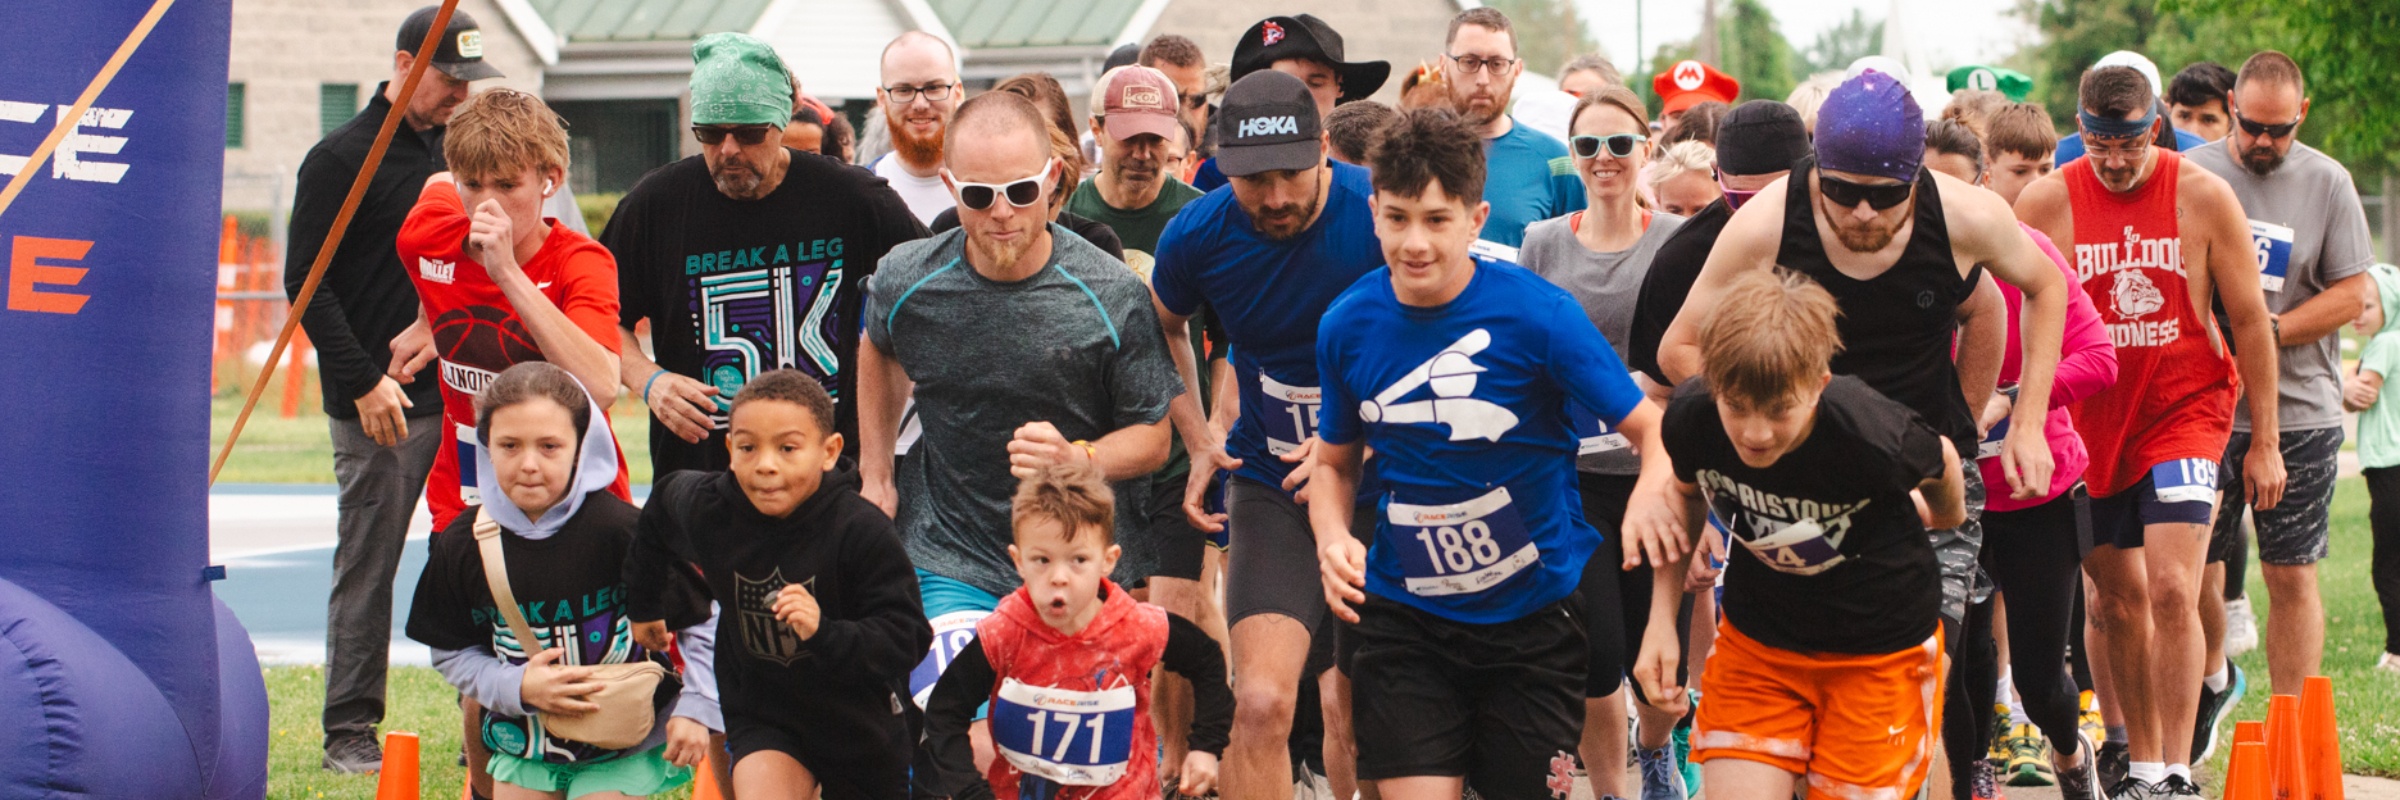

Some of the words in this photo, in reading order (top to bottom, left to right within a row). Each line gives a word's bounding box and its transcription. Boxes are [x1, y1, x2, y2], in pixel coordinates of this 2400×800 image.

[1678, 66, 1700, 80] M
[1976, 73, 1990, 91] L
[1238, 115, 1298, 138] HOKA
[685, 246, 767, 275] BREAK
[772, 244, 790, 265] A
[797, 237, 844, 262] LEG
[700, 259, 844, 412] 5K
[2106, 317, 2179, 348] ADNESS
[1415, 519, 1501, 575] 188
[553, 600, 574, 622] A
[1027, 709, 1105, 764] 171
